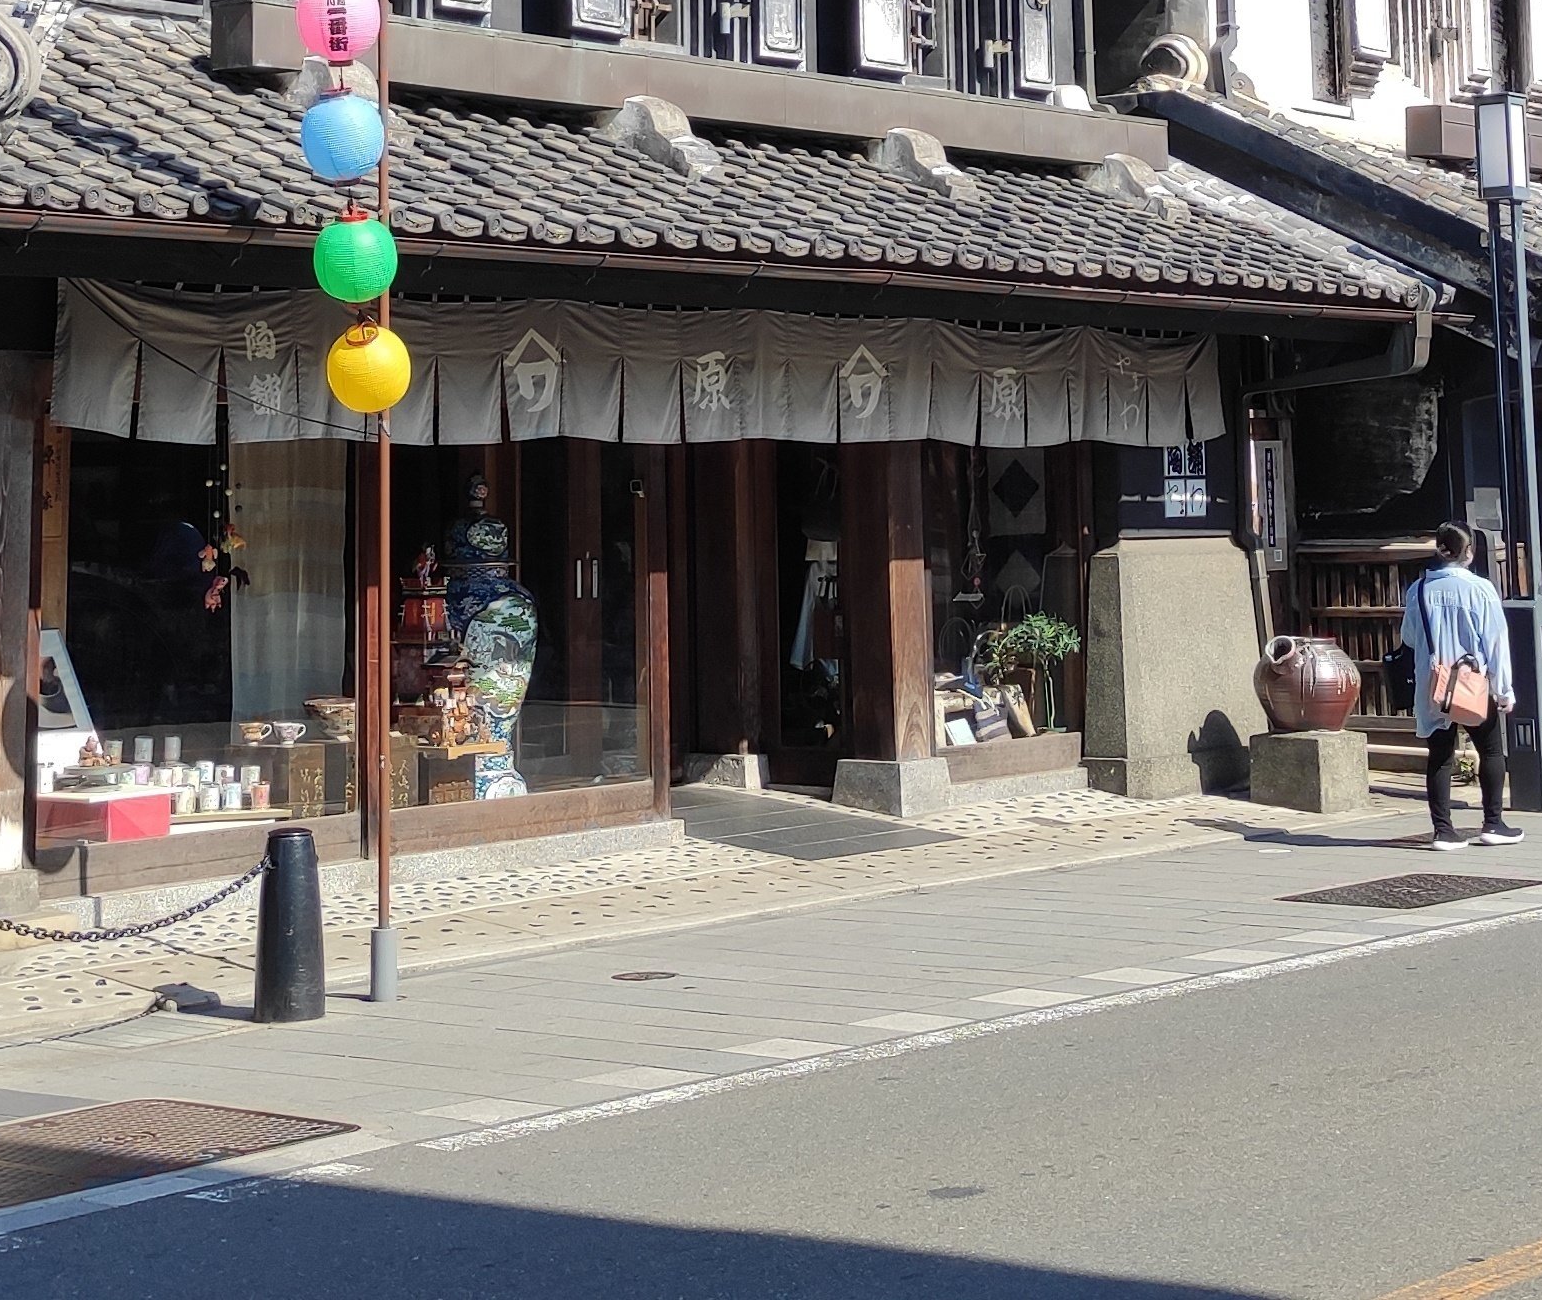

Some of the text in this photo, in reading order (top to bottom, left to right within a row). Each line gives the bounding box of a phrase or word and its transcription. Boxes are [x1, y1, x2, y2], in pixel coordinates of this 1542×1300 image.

[326, 7, 349, 52] 一番街
[243, 320, 281, 416] 陶舗
[692, 350, 730, 412] 原
[989, 367, 1023, 421] 原
[1115, 352, 1141, 431] やまわ
